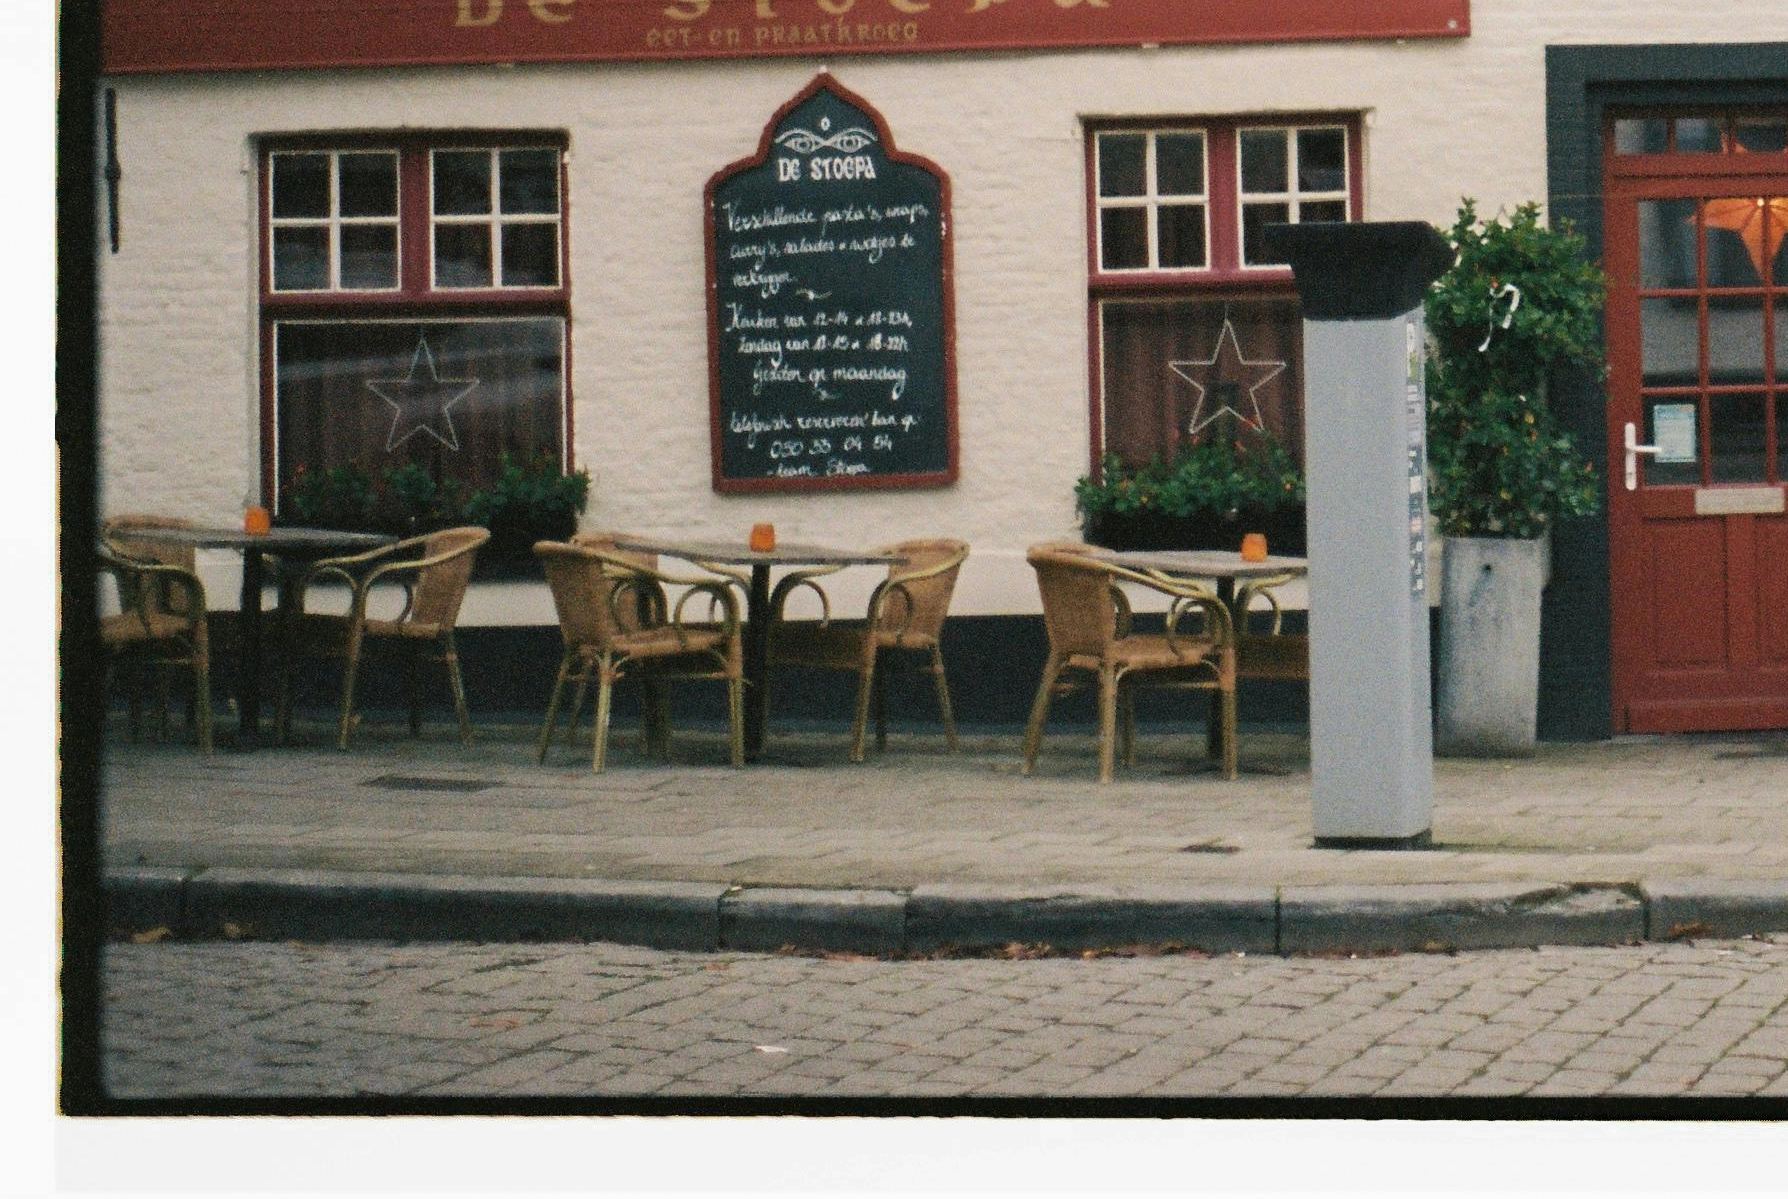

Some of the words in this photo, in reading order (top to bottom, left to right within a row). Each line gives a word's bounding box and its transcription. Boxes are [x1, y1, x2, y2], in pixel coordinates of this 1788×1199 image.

[778, 157, 800, 182] DE
[811, 155, 877, 181] STOEPA
[832, 365, 908, 401] maandag
